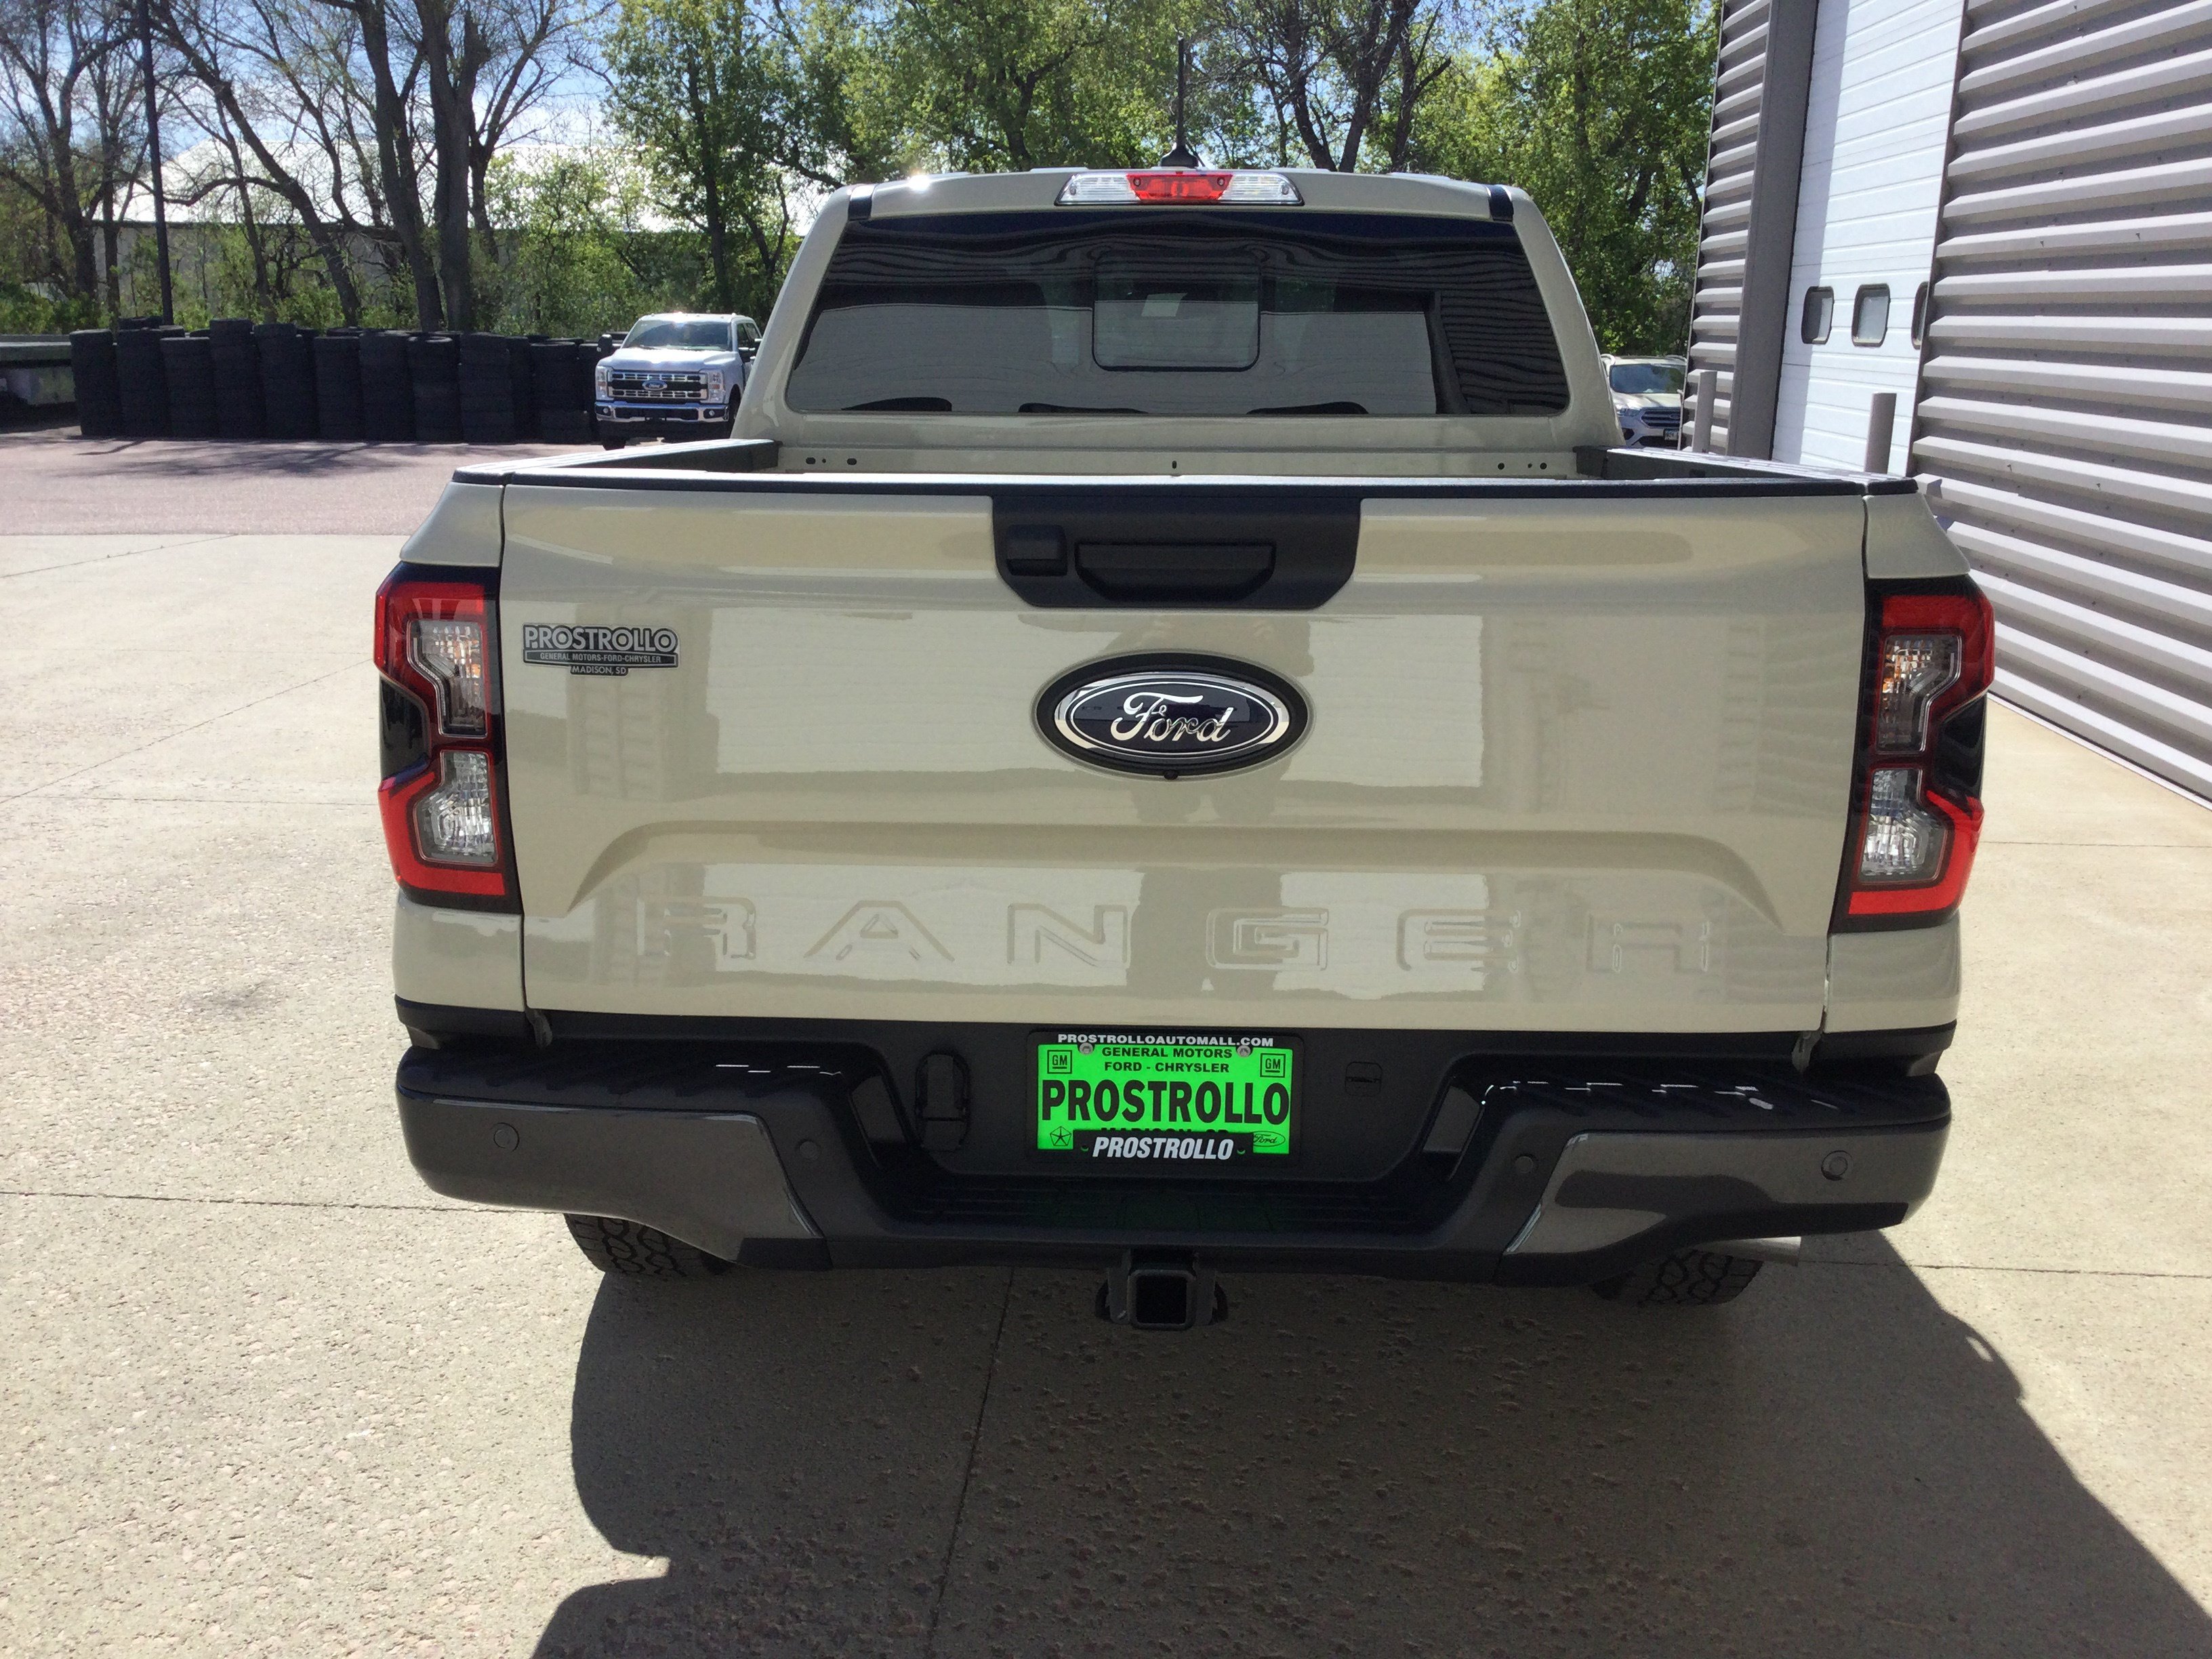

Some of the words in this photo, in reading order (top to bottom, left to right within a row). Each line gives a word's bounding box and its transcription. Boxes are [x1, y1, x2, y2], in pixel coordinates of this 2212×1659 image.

[524, 626, 677, 653] PROSTROLLO
[540, 652, 570, 661] GENERAL
[571, 665, 614, 675] MADISON,
[615, 666, 627, 674] SD
[1110, 691, 1234, 742] Ford
[637, 896, 1712, 973] RANGER
[1058, 1034, 1273, 1046] PROSTROLLOAUTOMALL.COM
[1102, 1047, 1168, 1057] GENERAL
[1172, 1048, 1232, 1058] MOTORS
[1052, 1054, 1067, 1066] GM
[1265, 1058, 1281, 1069] GM
[1104, 1061, 1142, 1071] FORD
[1155, 1062, 1229, 1073] CHRYSLER
[1042, 1079, 1290, 1125] PROSTROLLO
[1092, 1136, 1234, 1160] PROSTROLLO
